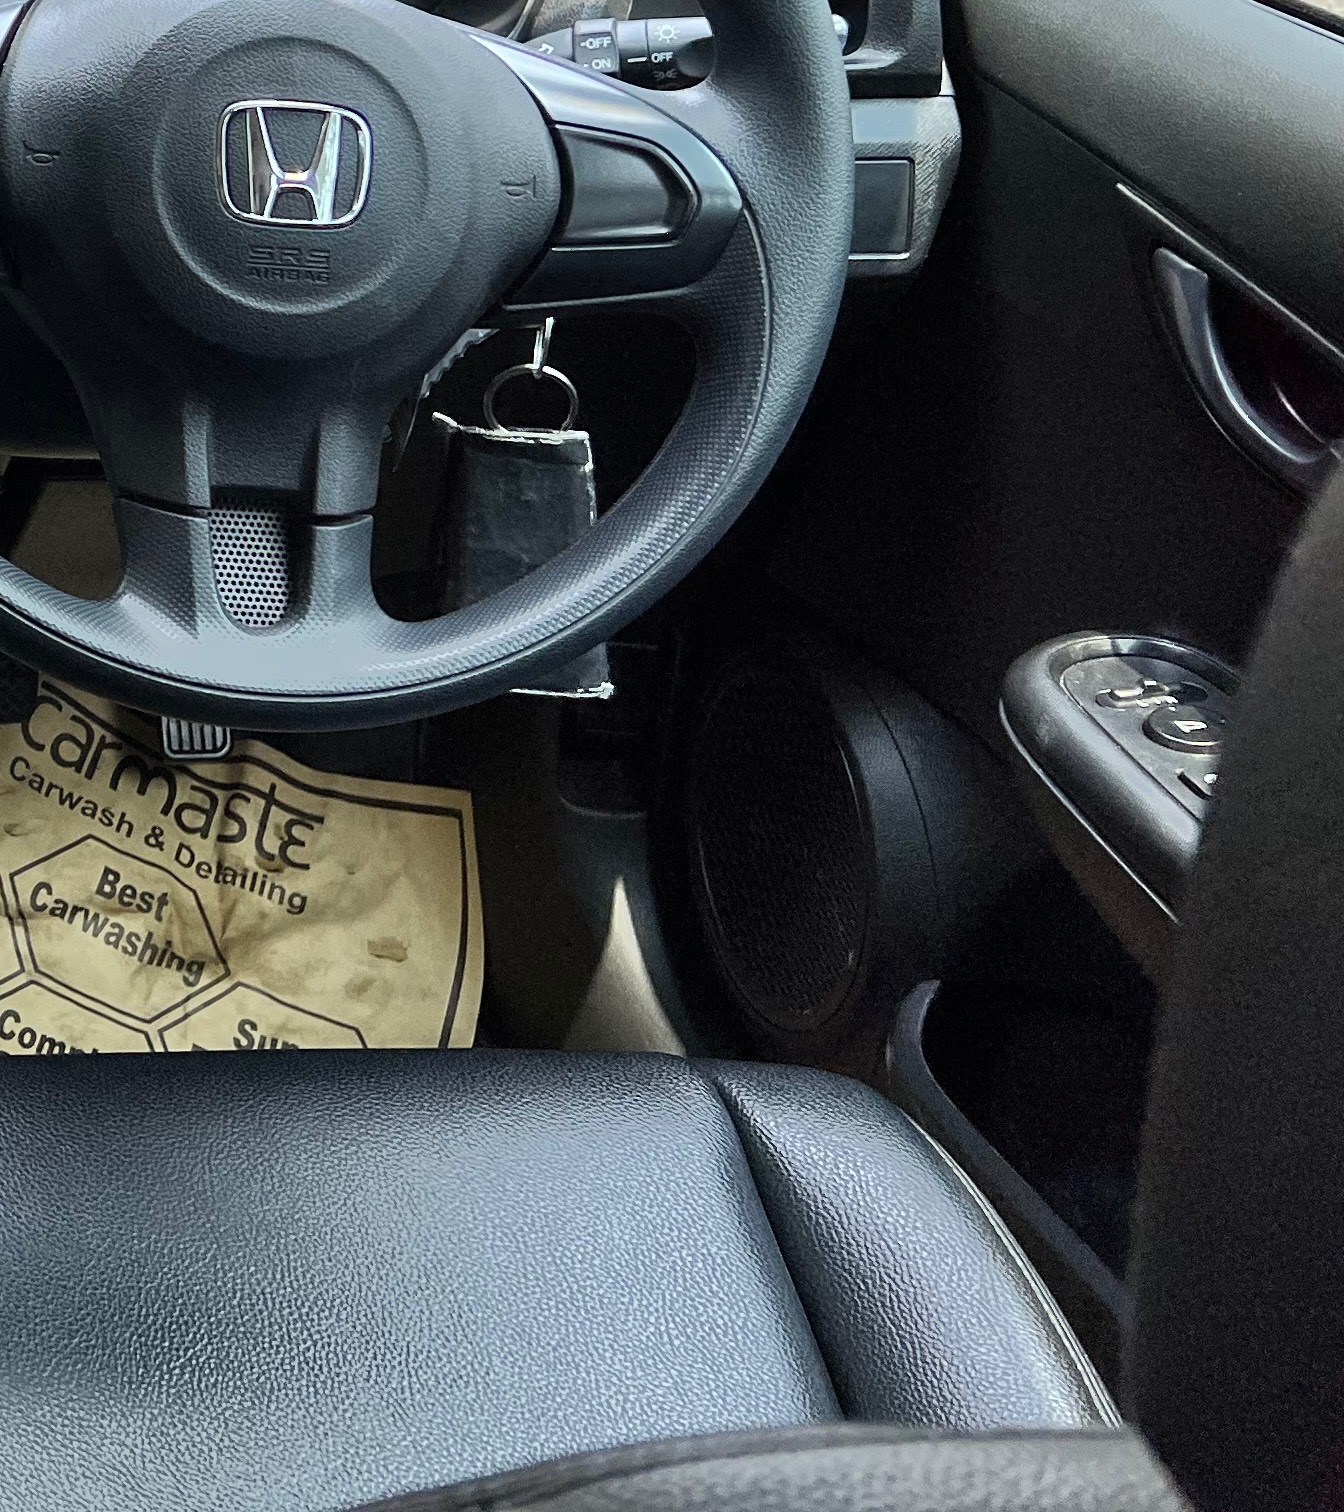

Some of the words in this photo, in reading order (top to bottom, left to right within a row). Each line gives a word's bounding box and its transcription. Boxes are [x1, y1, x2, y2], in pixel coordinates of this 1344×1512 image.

[586, 39, 612, 50] OFF
[592, 58, 611, 69] ON
[651, 52, 674, 63] OFF
[248, 245, 330, 265] SRS
[245, 268, 330, 285] AIRBAG
[8, 755, 135, 838] Carwash
[145, 825, 166, 851] &
[175, 839, 309, 917] Detailing
[95, 865, 170, 921] Best
[28, 881, 207, 988] Carwashing
